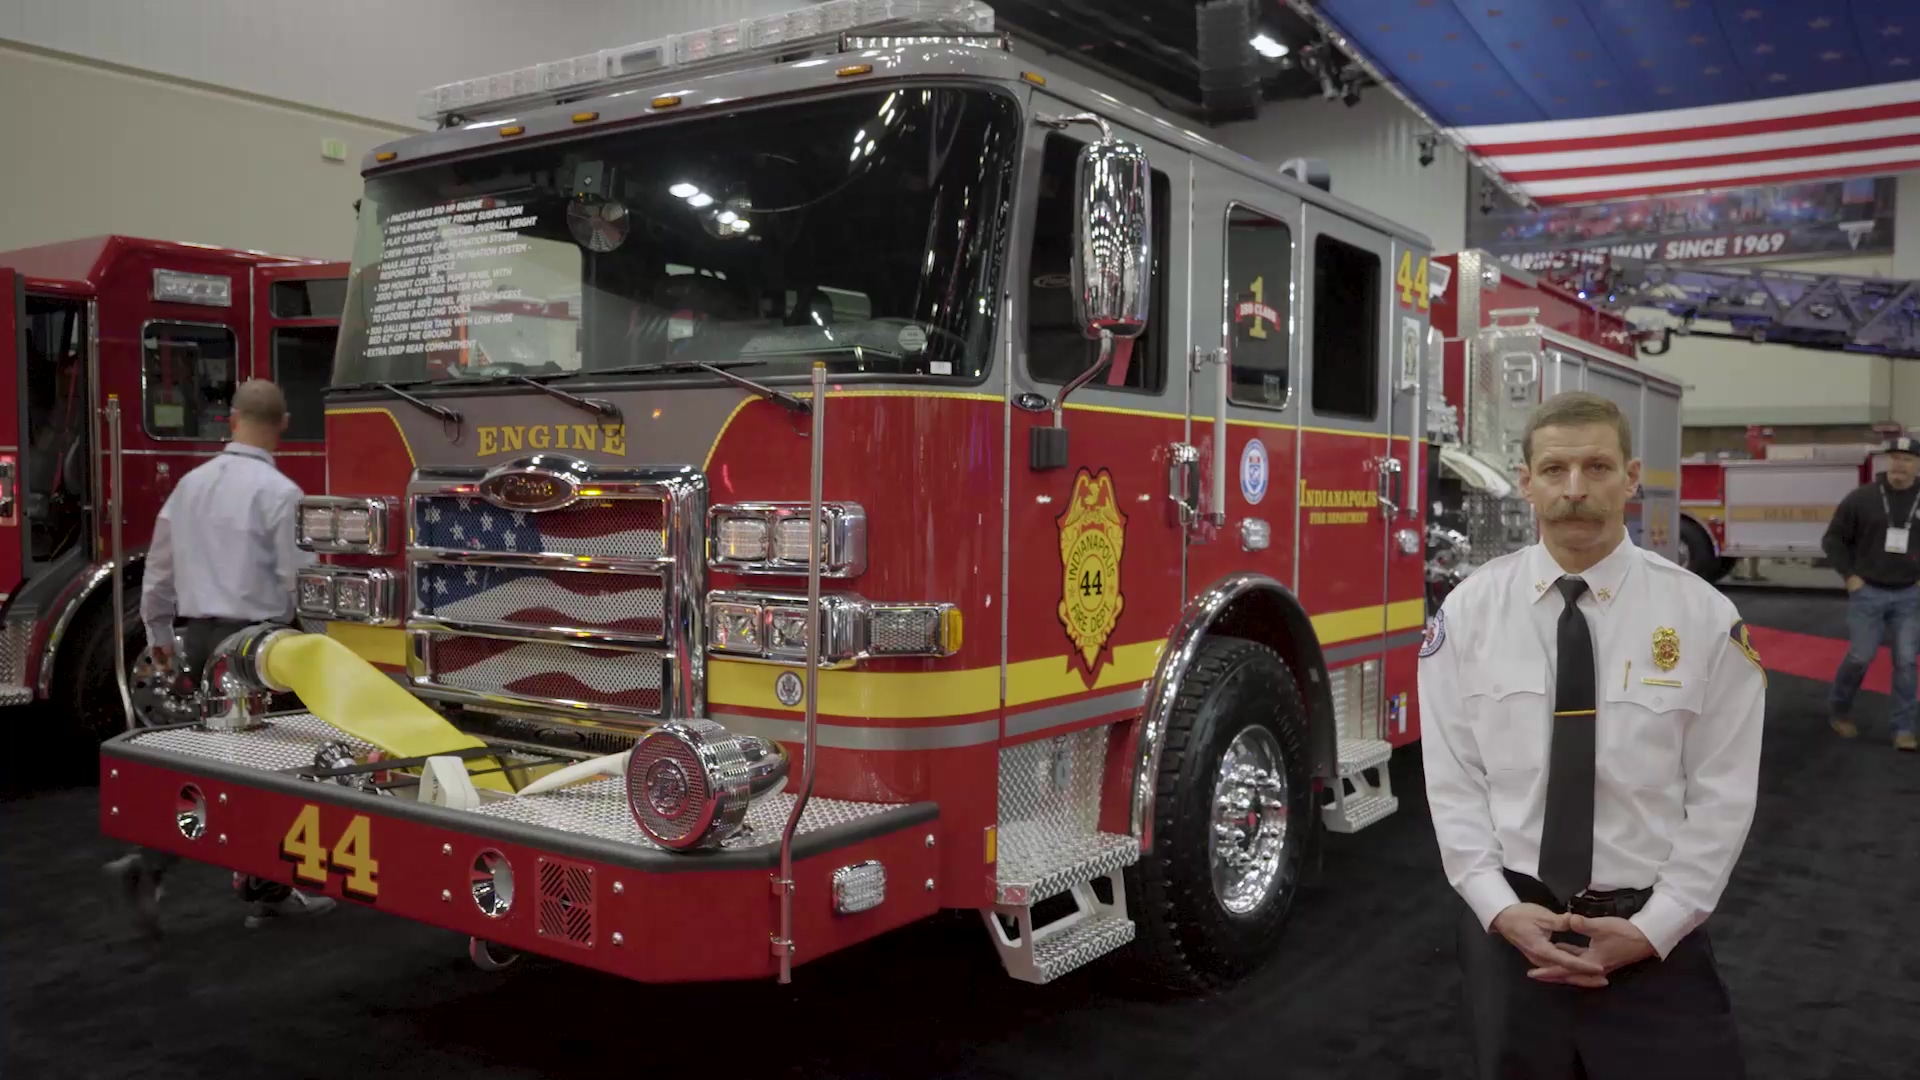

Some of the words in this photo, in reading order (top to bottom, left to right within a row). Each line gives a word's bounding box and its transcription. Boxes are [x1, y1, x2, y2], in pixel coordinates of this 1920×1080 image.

[390, 211, 416, 222] PACCAR
[434, 205, 445, 215] 510
[446, 204, 456, 213] HP
[456, 199, 483, 212] ENGINE
[407, 216, 452, 232] INDEPENDENT
[452, 212, 477, 224] FRONT
[478, 206, 524, 220] SUSPENSION
[386, 236, 401, 247] FLAT
[402, 234, 416, 244] CAB
[442, 225, 474, 237] REDUCED
[475, 220, 508, 232] OVERALL
[509, 216, 538, 228] HEIGHT
[384, 248, 402, 259] CREW
[402, 244, 432, 256] PROTECT
[449, 237, 488, 248] FILTRATION
[489, 232, 518, 242] SYSTEM
[400, 257, 420, 268] ALERT
[420, 252, 455, 265] COLLISION
[456, 248, 497, 259] MITIGATION
[498, 243, 527, 254] SYSTEM
[1612, 242, 1658, 260] WAY
[1666, 237, 1726, 261] SINCE
[1732, 233, 1785, 254] 1969
[378, 282, 391, 292] TOP
[391, 279, 414, 290] MOUNT
[414, 275, 445, 286] CONTROL
[448, 273, 466, 282] PUMP
[493, 267, 512, 277] WITH
[380, 266, 416, 280] RESPONDER
[417, 266, 427, 274] TO
[428, 261, 456, 272] VEHICLE
[1396, 249, 1429, 311] 44
[376, 292, 392, 302] 2000
[408, 288, 423, 297] TWO
[424, 284, 445, 295] STAGE
[448, 282, 471, 292] WATER
[472, 279, 492, 289] PUMP
[373, 314, 381, 323] TO
[381, 311, 410, 322] LADDERS
[411, 309, 426, 318] AND
[427, 307, 446, 317] LONG
[448, 304, 470, 314] TOOLS
[374, 303, 397, 314] HEIGHT
[397, 300, 416, 311] RIGHT
[417, 296, 432, 308] SIDE
[433, 296, 455, 306] PANEL
[457, 294, 471, 303] FOR
[1250, 276, 1267, 338] 1
[1254, 302, 1277, 323] CLASS
[383, 323, 409, 333] GALLON
[410, 320, 433, 331] WATER
[434, 318, 453, 328] TANK
[454, 317, 472, 327] WITH
[474, 315, 492, 325] LOW
[493, 313, 514, 323] HOSE
[366, 347, 387, 358] EXTRA
[388, 345, 405, 355] DEEP
[406, 344, 424, 353] REAR
[424, 340, 476, 352] COMPARTMENT
[368, 335, 381, 345] BED
[394, 332, 408, 342] OFF
[408, 331, 421, 340] THE
[422, 328, 452, 340] GROUND
[477, 424, 626, 457] ENGINE
[1300, 479, 1377, 507] INDIANAPOLIS
[1309, 512, 1326, 524] FIRE
[1327, 511, 1368, 524] DEPARTMENT
[1068, 533, 1115, 582] INDIANAPOLIS
[1080, 570, 1103, 597] 44
[1070, 604, 1088, 633] FIRE
[1090, 603, 1113, 633] DEPT.
[282, 804, 379, 898] 44
